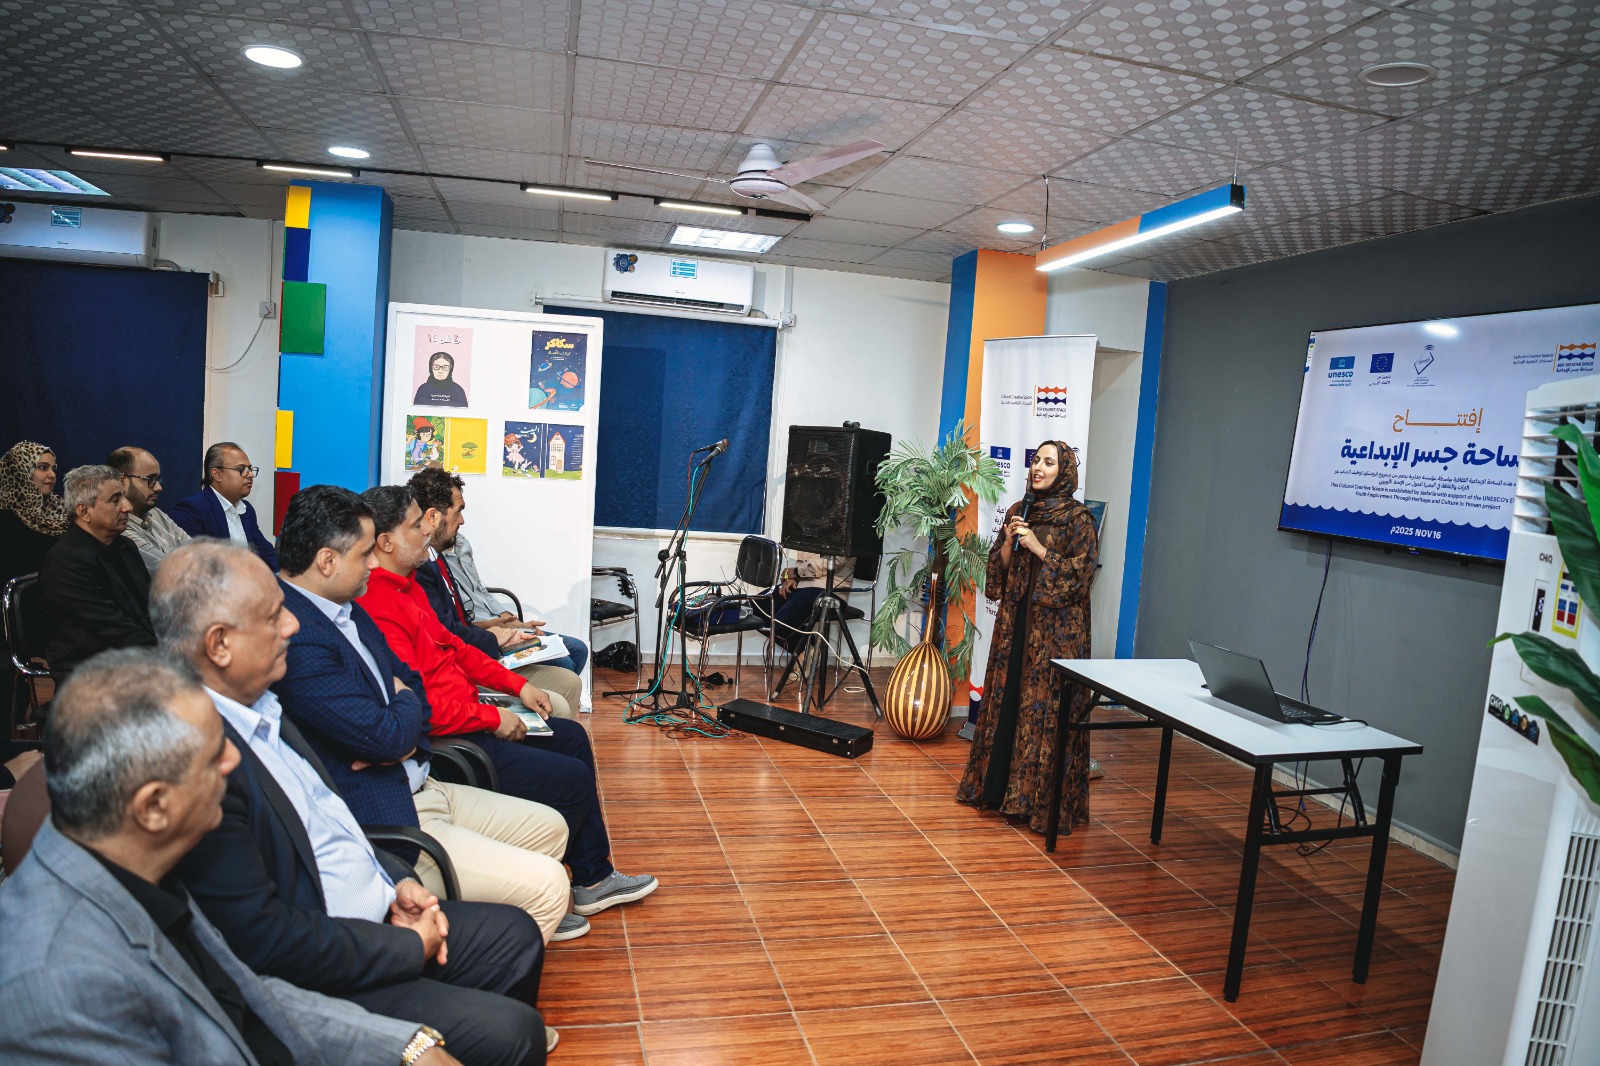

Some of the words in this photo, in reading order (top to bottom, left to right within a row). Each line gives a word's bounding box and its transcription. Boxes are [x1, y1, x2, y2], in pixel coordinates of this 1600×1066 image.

[1341, 439, 1410, 469] الإبداعية
[1411, 446, 1458, 471] جسر
[1463, 442, 1519, 467] ساحة
[1482, 503, 1501, 511] project
[1483, 495, 1508, 503] UNESCO's
